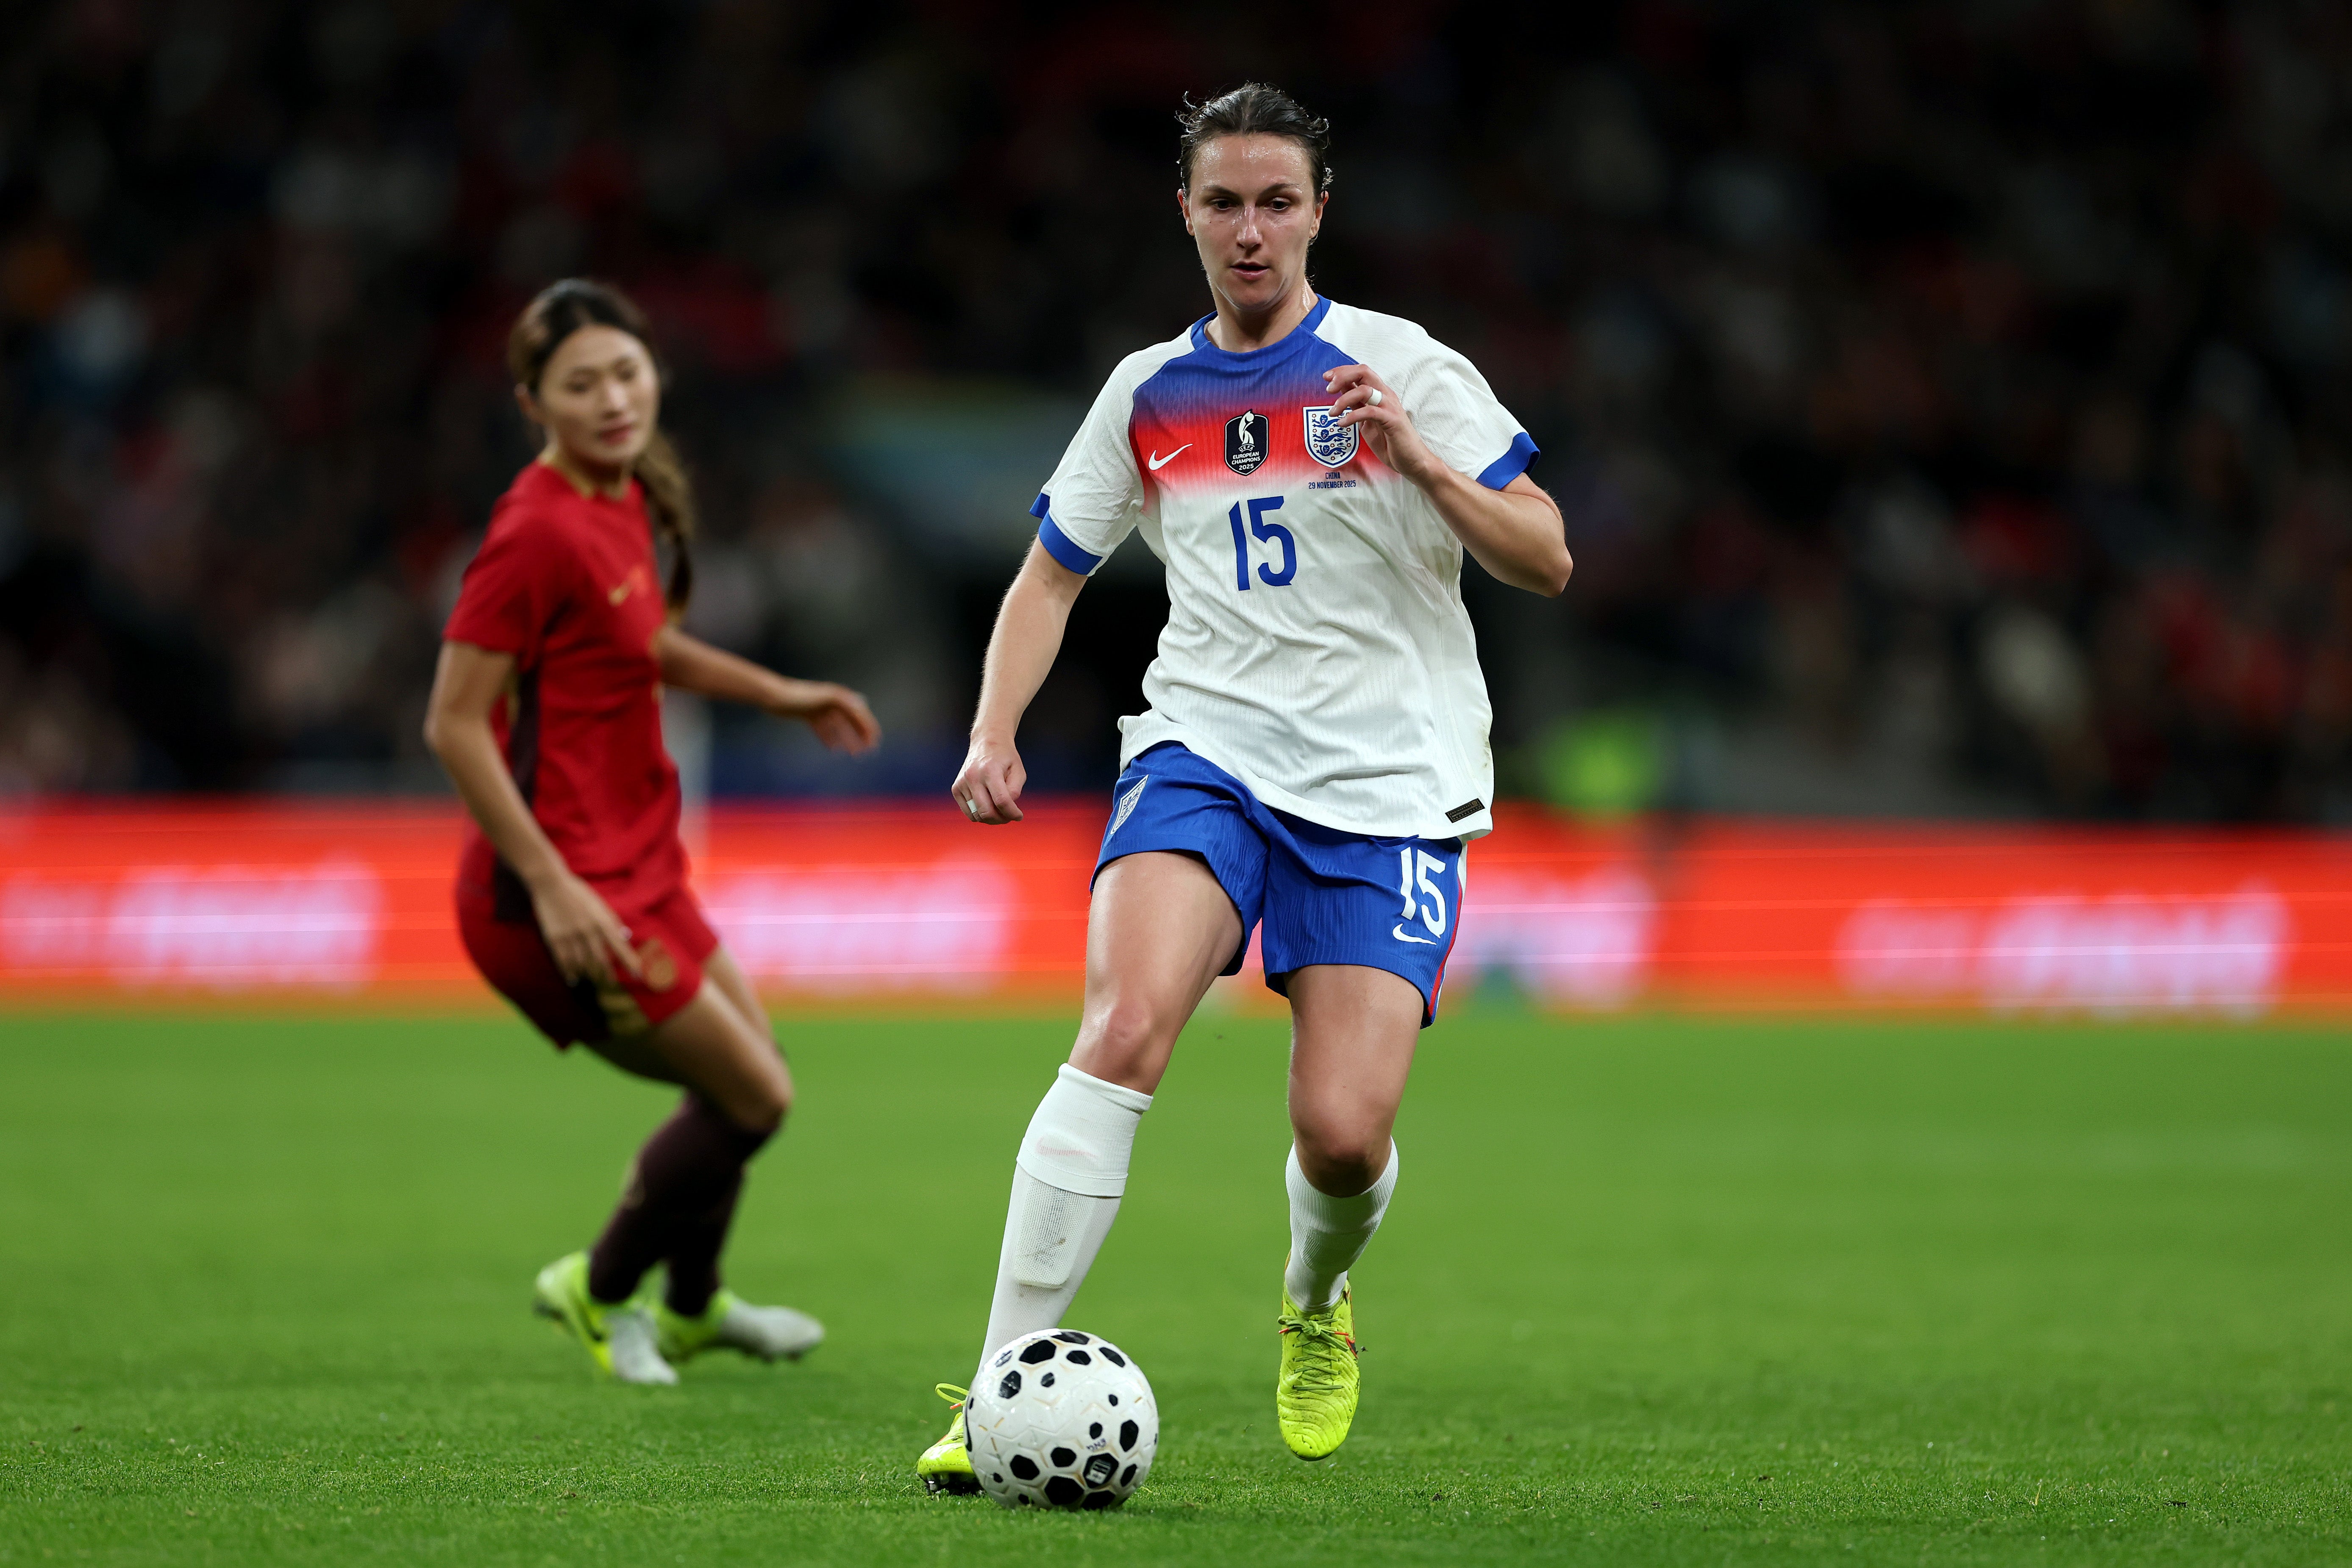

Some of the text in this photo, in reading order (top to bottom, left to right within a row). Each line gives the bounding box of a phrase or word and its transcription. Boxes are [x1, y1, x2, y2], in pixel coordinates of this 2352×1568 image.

[1232, 456, 1260, 465] CHAMPIONS
[1233, 451, 1259, 460] EUROPEAN
[1229, 495, 1297, 591] 15
[1401, 846, 1446, 939] 15
